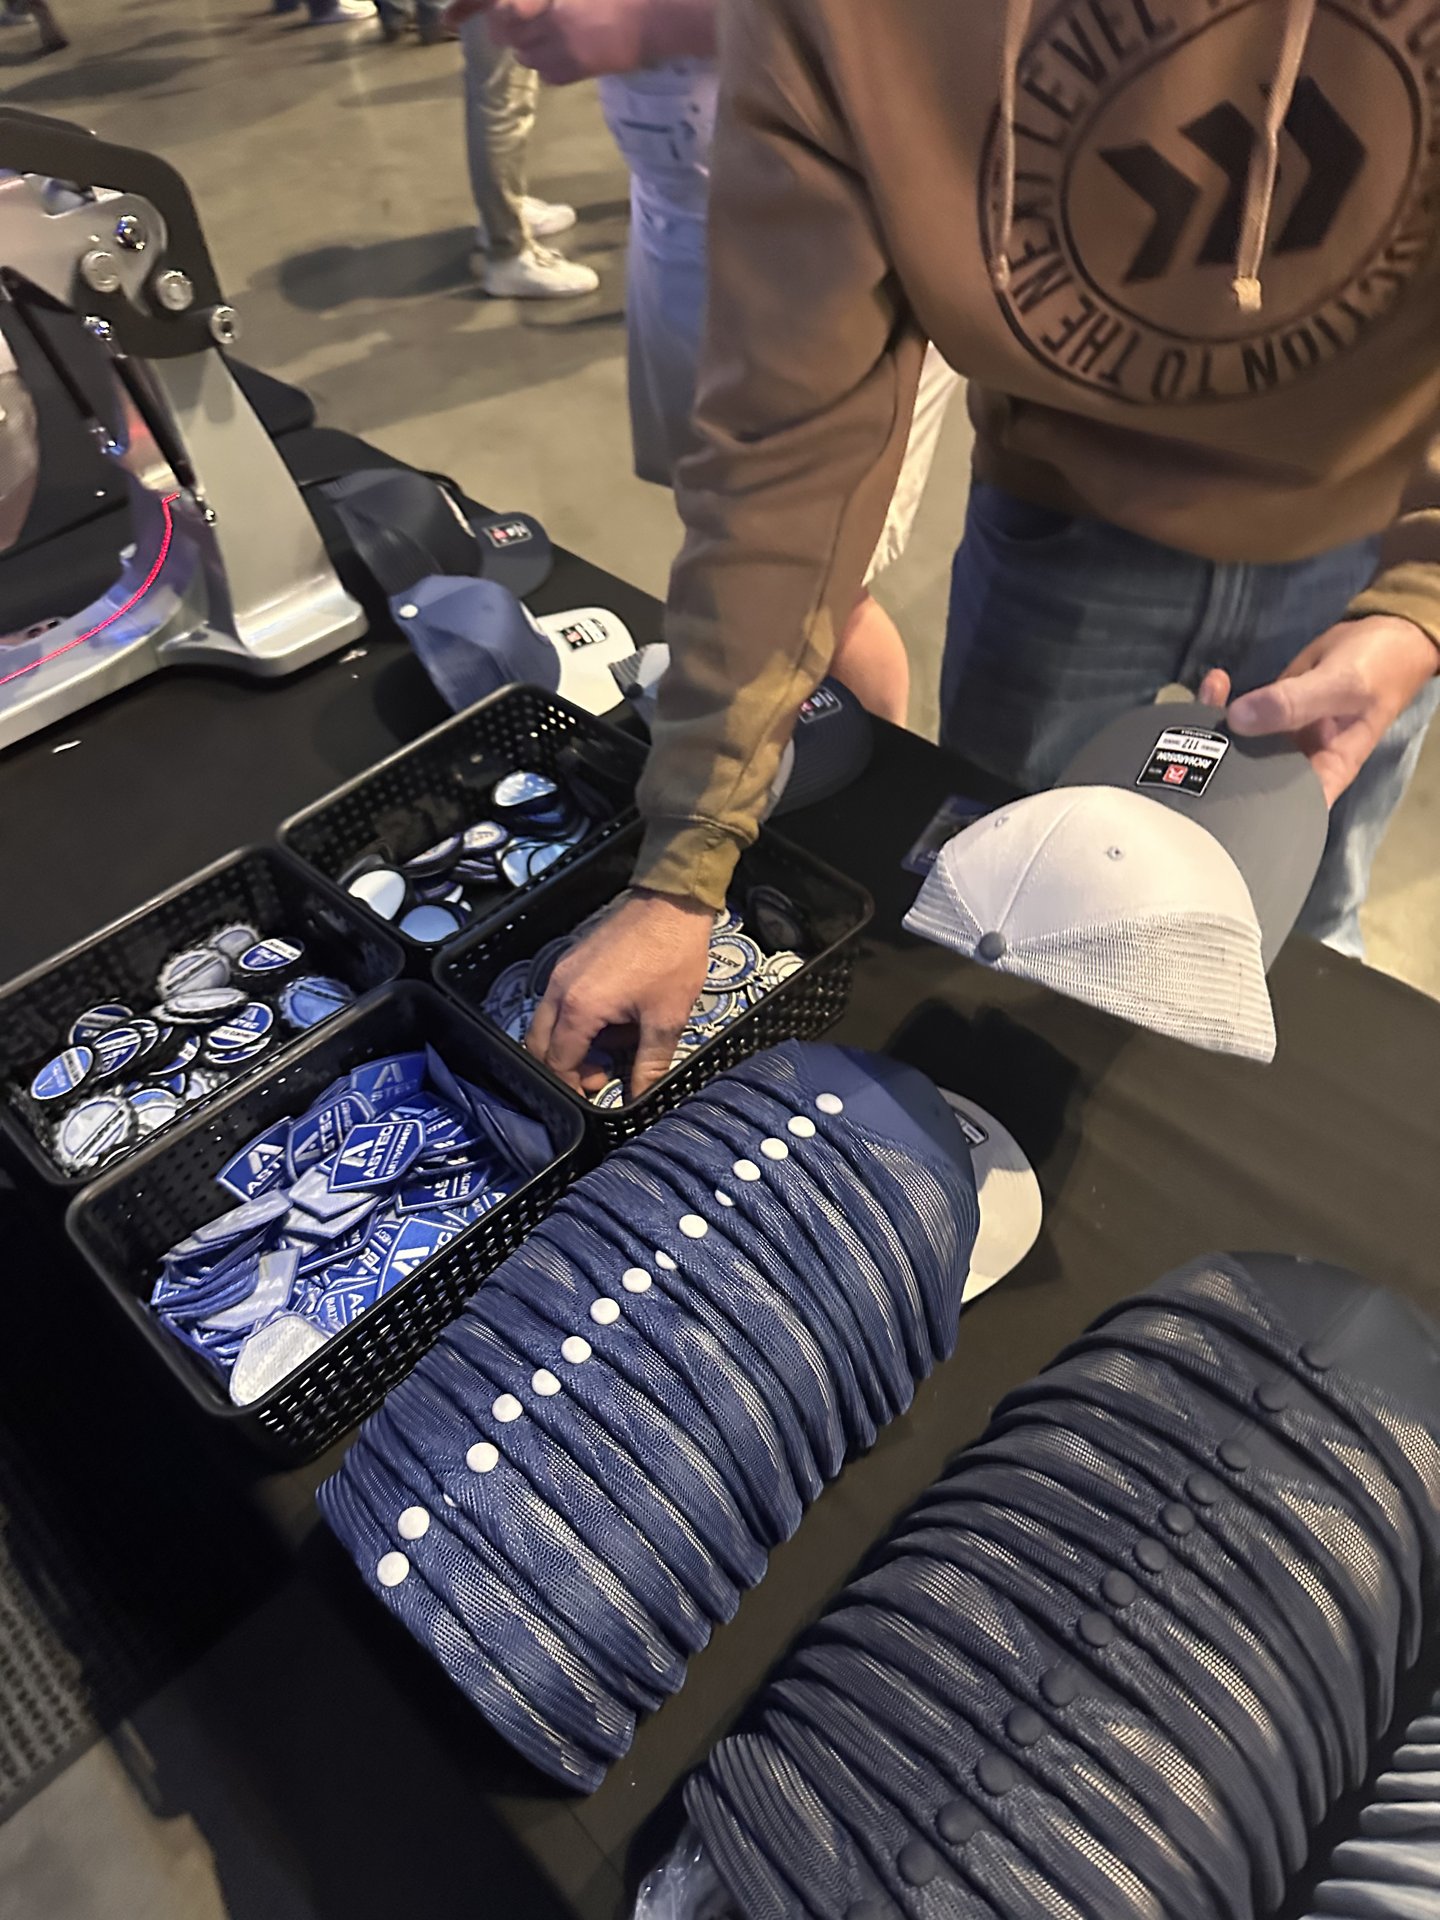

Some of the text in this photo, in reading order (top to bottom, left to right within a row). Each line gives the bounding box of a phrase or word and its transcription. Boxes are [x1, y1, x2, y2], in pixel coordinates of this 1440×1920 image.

[1012, 0, 1177, 148] LEVEL
[1040, 294, 1142, 389] THE
[1151, 348, 1217, 400] TO
[1182, 738, 1200, 750] 112
[707, 951, 741, 968] ASTEC
[319, 1110, 336, 1153] STEC
[363, 1125, 395, 1178] ASTEC
[247, 1155, 285, 1195] AST
